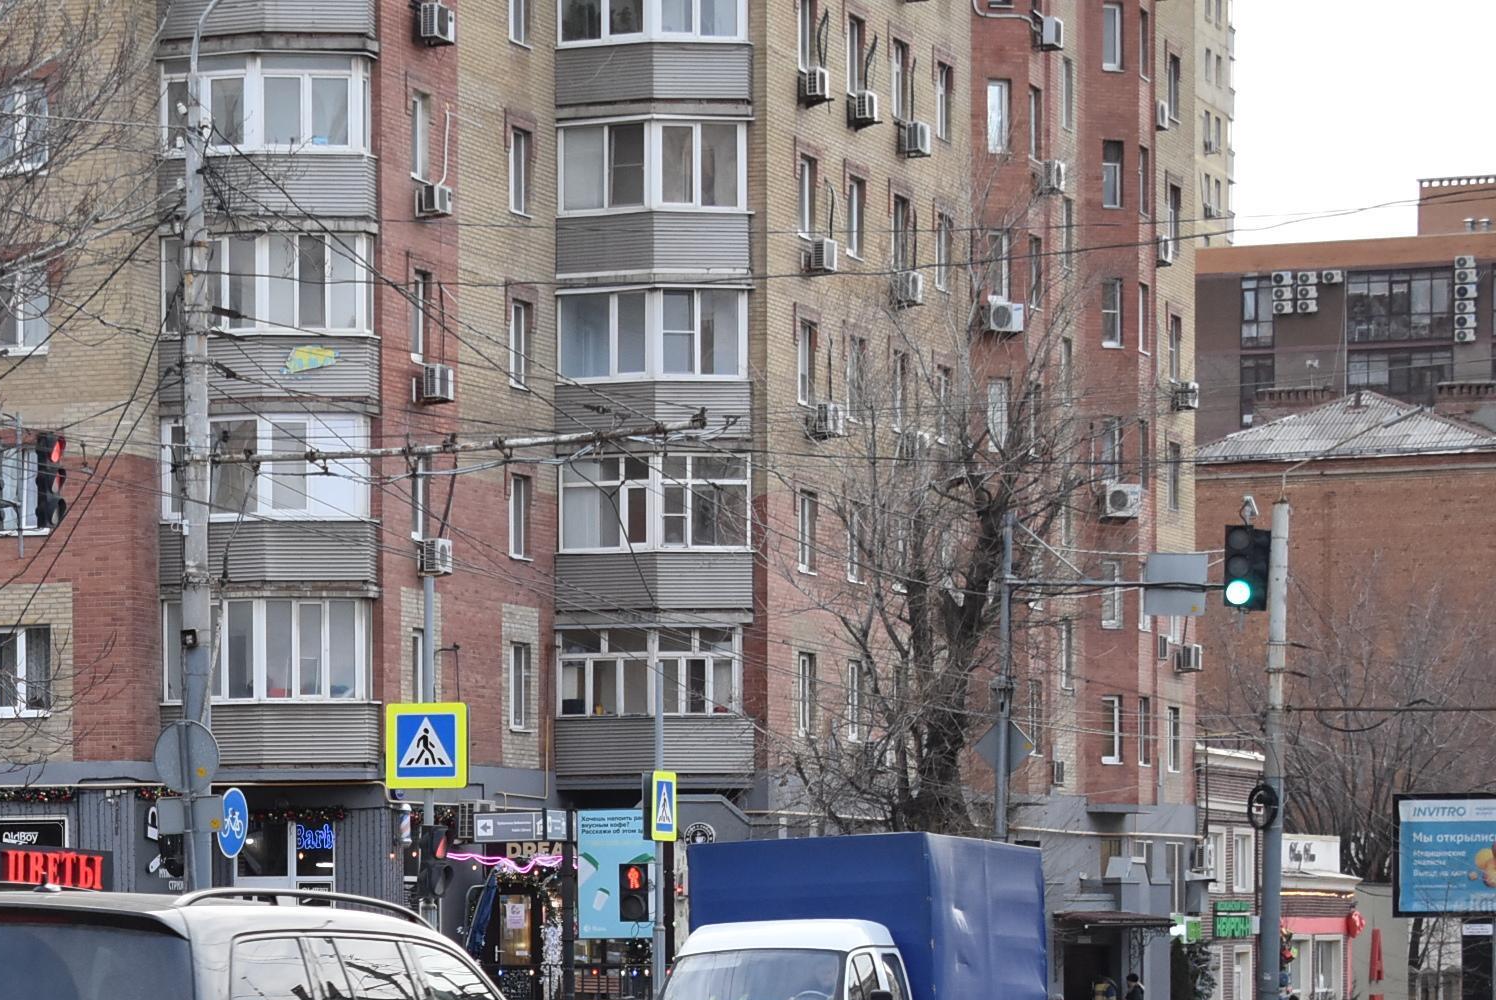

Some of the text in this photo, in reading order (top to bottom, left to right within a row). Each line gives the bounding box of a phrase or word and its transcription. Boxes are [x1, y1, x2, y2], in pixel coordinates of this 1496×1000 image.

[1412, 806, 1466, 817] INVITRO
[1412, 832, 1433, 843] Мы
[506, 842, 576, 858] DREA
[7, 850, 104, 892] ЦВЕТЫ
